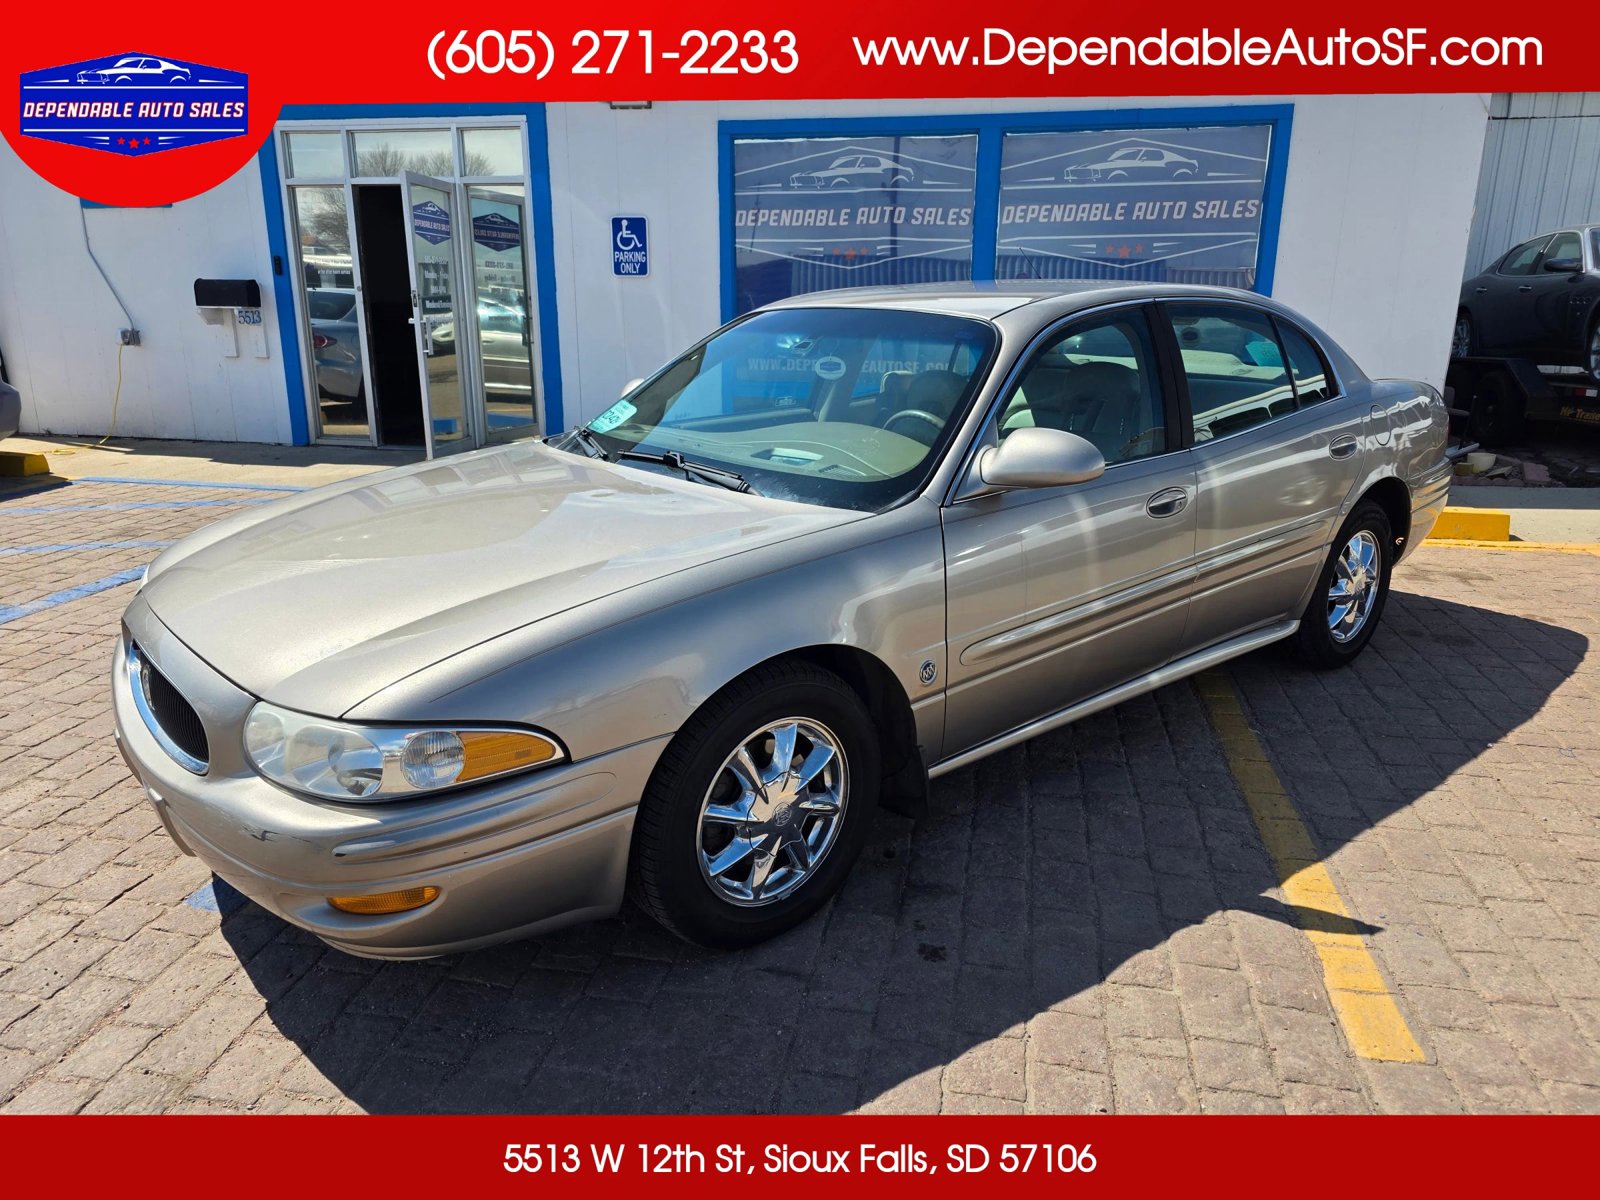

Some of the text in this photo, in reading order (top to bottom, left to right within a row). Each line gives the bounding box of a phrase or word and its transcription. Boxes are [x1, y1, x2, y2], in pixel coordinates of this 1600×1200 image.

[735, 206, 972, 227] DEPENDABLE AUTO SALES
[1001, 199, 1259, 225] DEPENDABLE AUTO SALES
[614, 251, 646, 263] PARKING
[620, 262, 640, 274] ONLY
[238, 310, 262, 325] 5513
